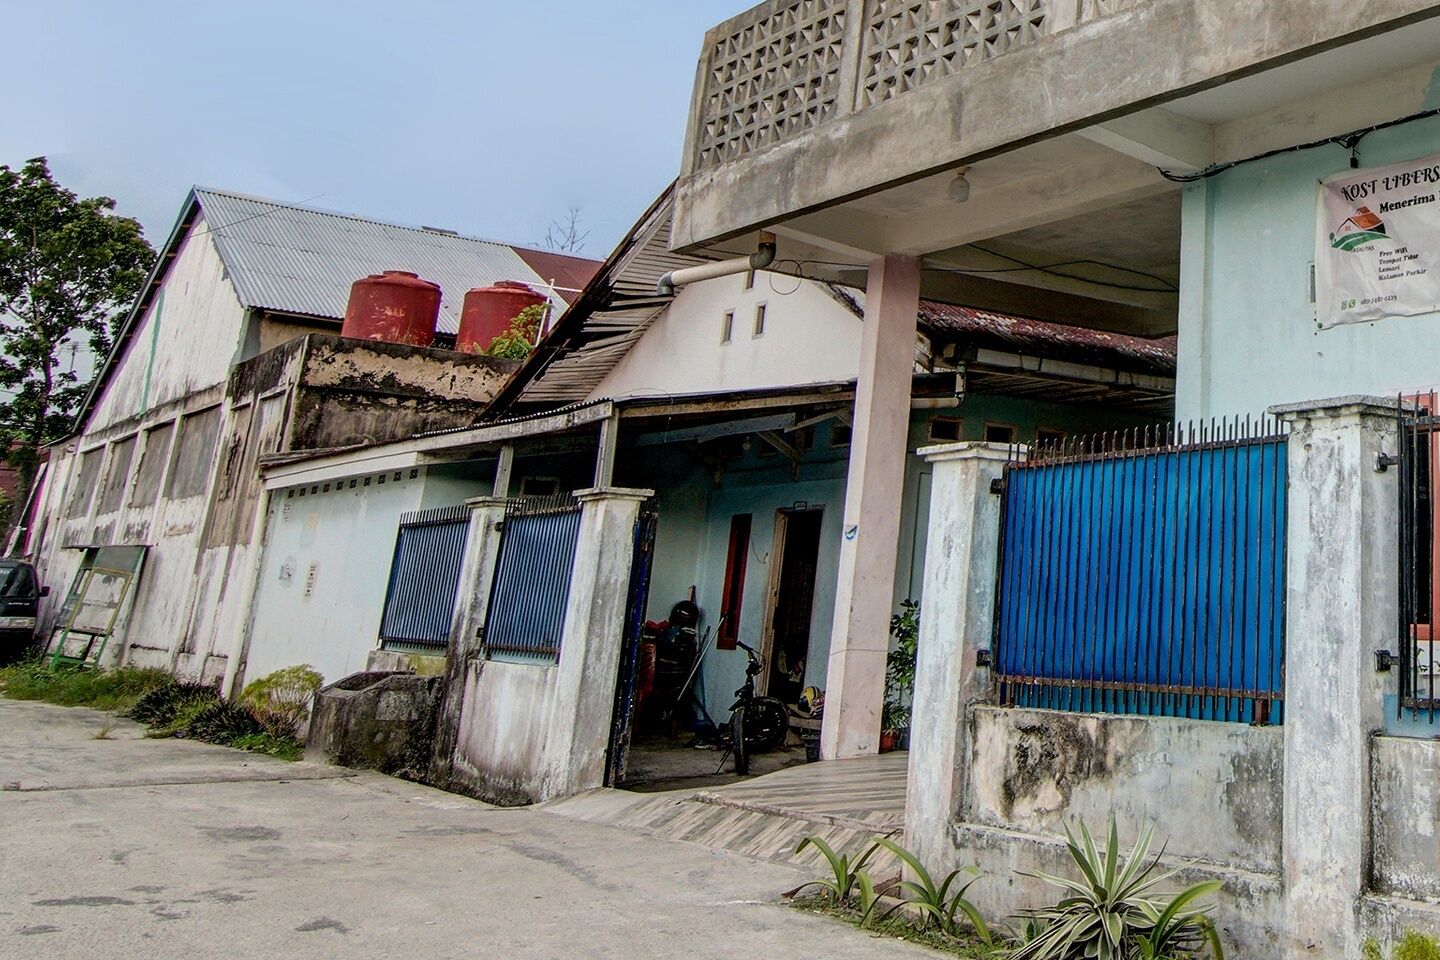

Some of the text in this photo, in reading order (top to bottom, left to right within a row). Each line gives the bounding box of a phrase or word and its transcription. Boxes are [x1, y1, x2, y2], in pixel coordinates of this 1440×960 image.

[1341, 180, 1378, 201] KOST
[1380, 194, 1435, 213] Menerima
[1379, 256, 1402, 265] Tempat
[1378, 264, 1400, 273] Lemari
[1406, 269, 1426, 277] Parkir
